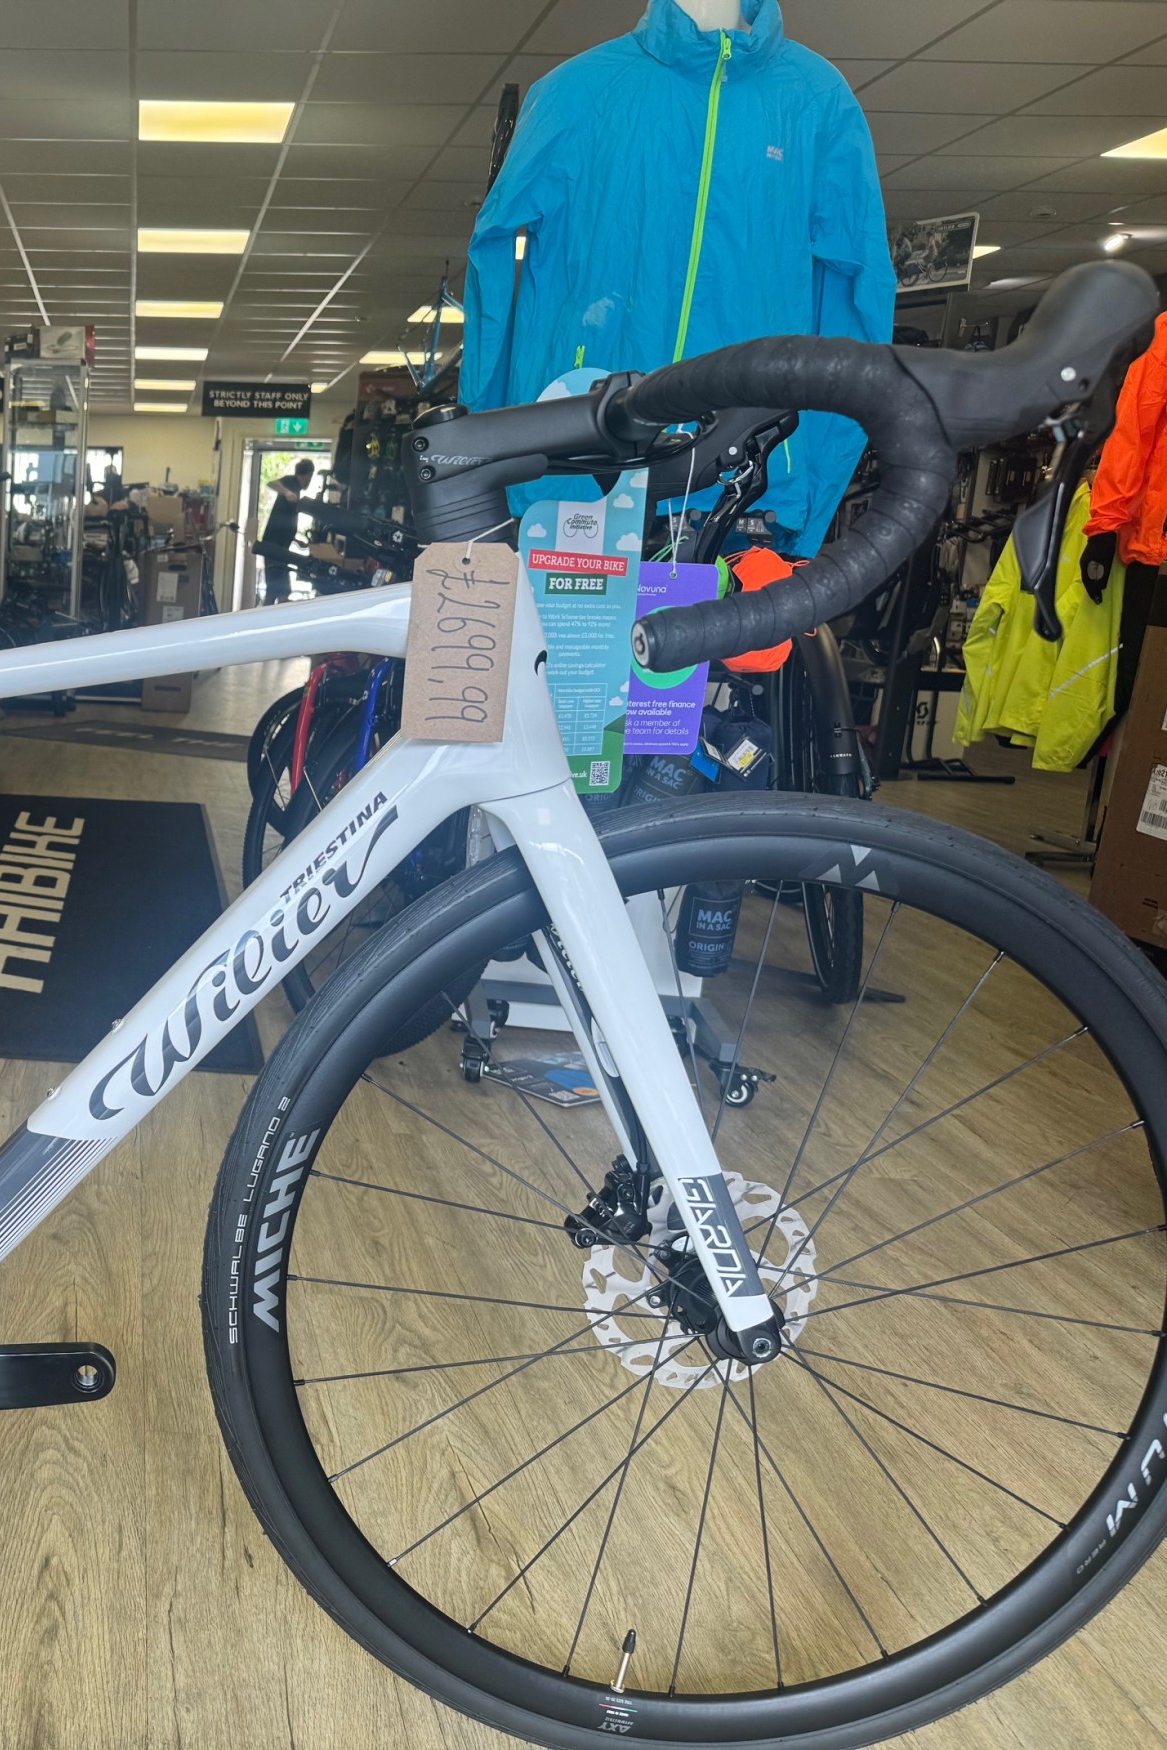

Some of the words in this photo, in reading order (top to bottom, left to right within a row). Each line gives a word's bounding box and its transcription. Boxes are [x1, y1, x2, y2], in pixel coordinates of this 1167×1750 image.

[209, 390, 252, 399] STRICTLY
[254, 392, 282, 400] STAFF
[284, 392, 309, 401] ONLY
[213, 399, 251, 408] BEYOND
[253, 400, 273, 409] THIS
[275, 401, 303, 410] POINT
[566, 518, 598, 526] Commute
[532, 553, 575, 567] UPGRADE
[576, 557, 602, 569] YOUR
[603, 560, 625, 571] BIKE
[549, 577, 573, 590] FOR
[574, 577, 604, 590] FREE
[627, 700, 652, 708] terest
[652, 699, 668, 708] free
[668, 700, 696, 709] finance
[638, 708, 672, 716] available
[640, 719, 671, 727] member
[672, 719, 681, 727] of
[632, 727, 651, 735] team
[652, 726, 664, 735] for
[664, 727, 690, 735] details
[650, 756, 687, 782] MAC
[662, 776, 682, 790] SAC
[279, 790, 388, 903] TRIESTINA
[697, 909, 733, 923] MAC
[696, 921, 706, 930] IN
[707, 923, 714, 931] A
[715, 922, 731, 931] SAC
[688, 941, 725, 952] ORIGIN
[88, 804, 399, 1125] Wilier
[228, 1211, 249, 1345] SCHWALBE
[243, 1116, 279, 1202] LUGANO
[277, 1095, 291, 1110] 2
[252, 1128, 320, 1333] MICHE
[678, 1177, 744, 1297] GARDA
[596, 1722, 631, 1733] AXY
